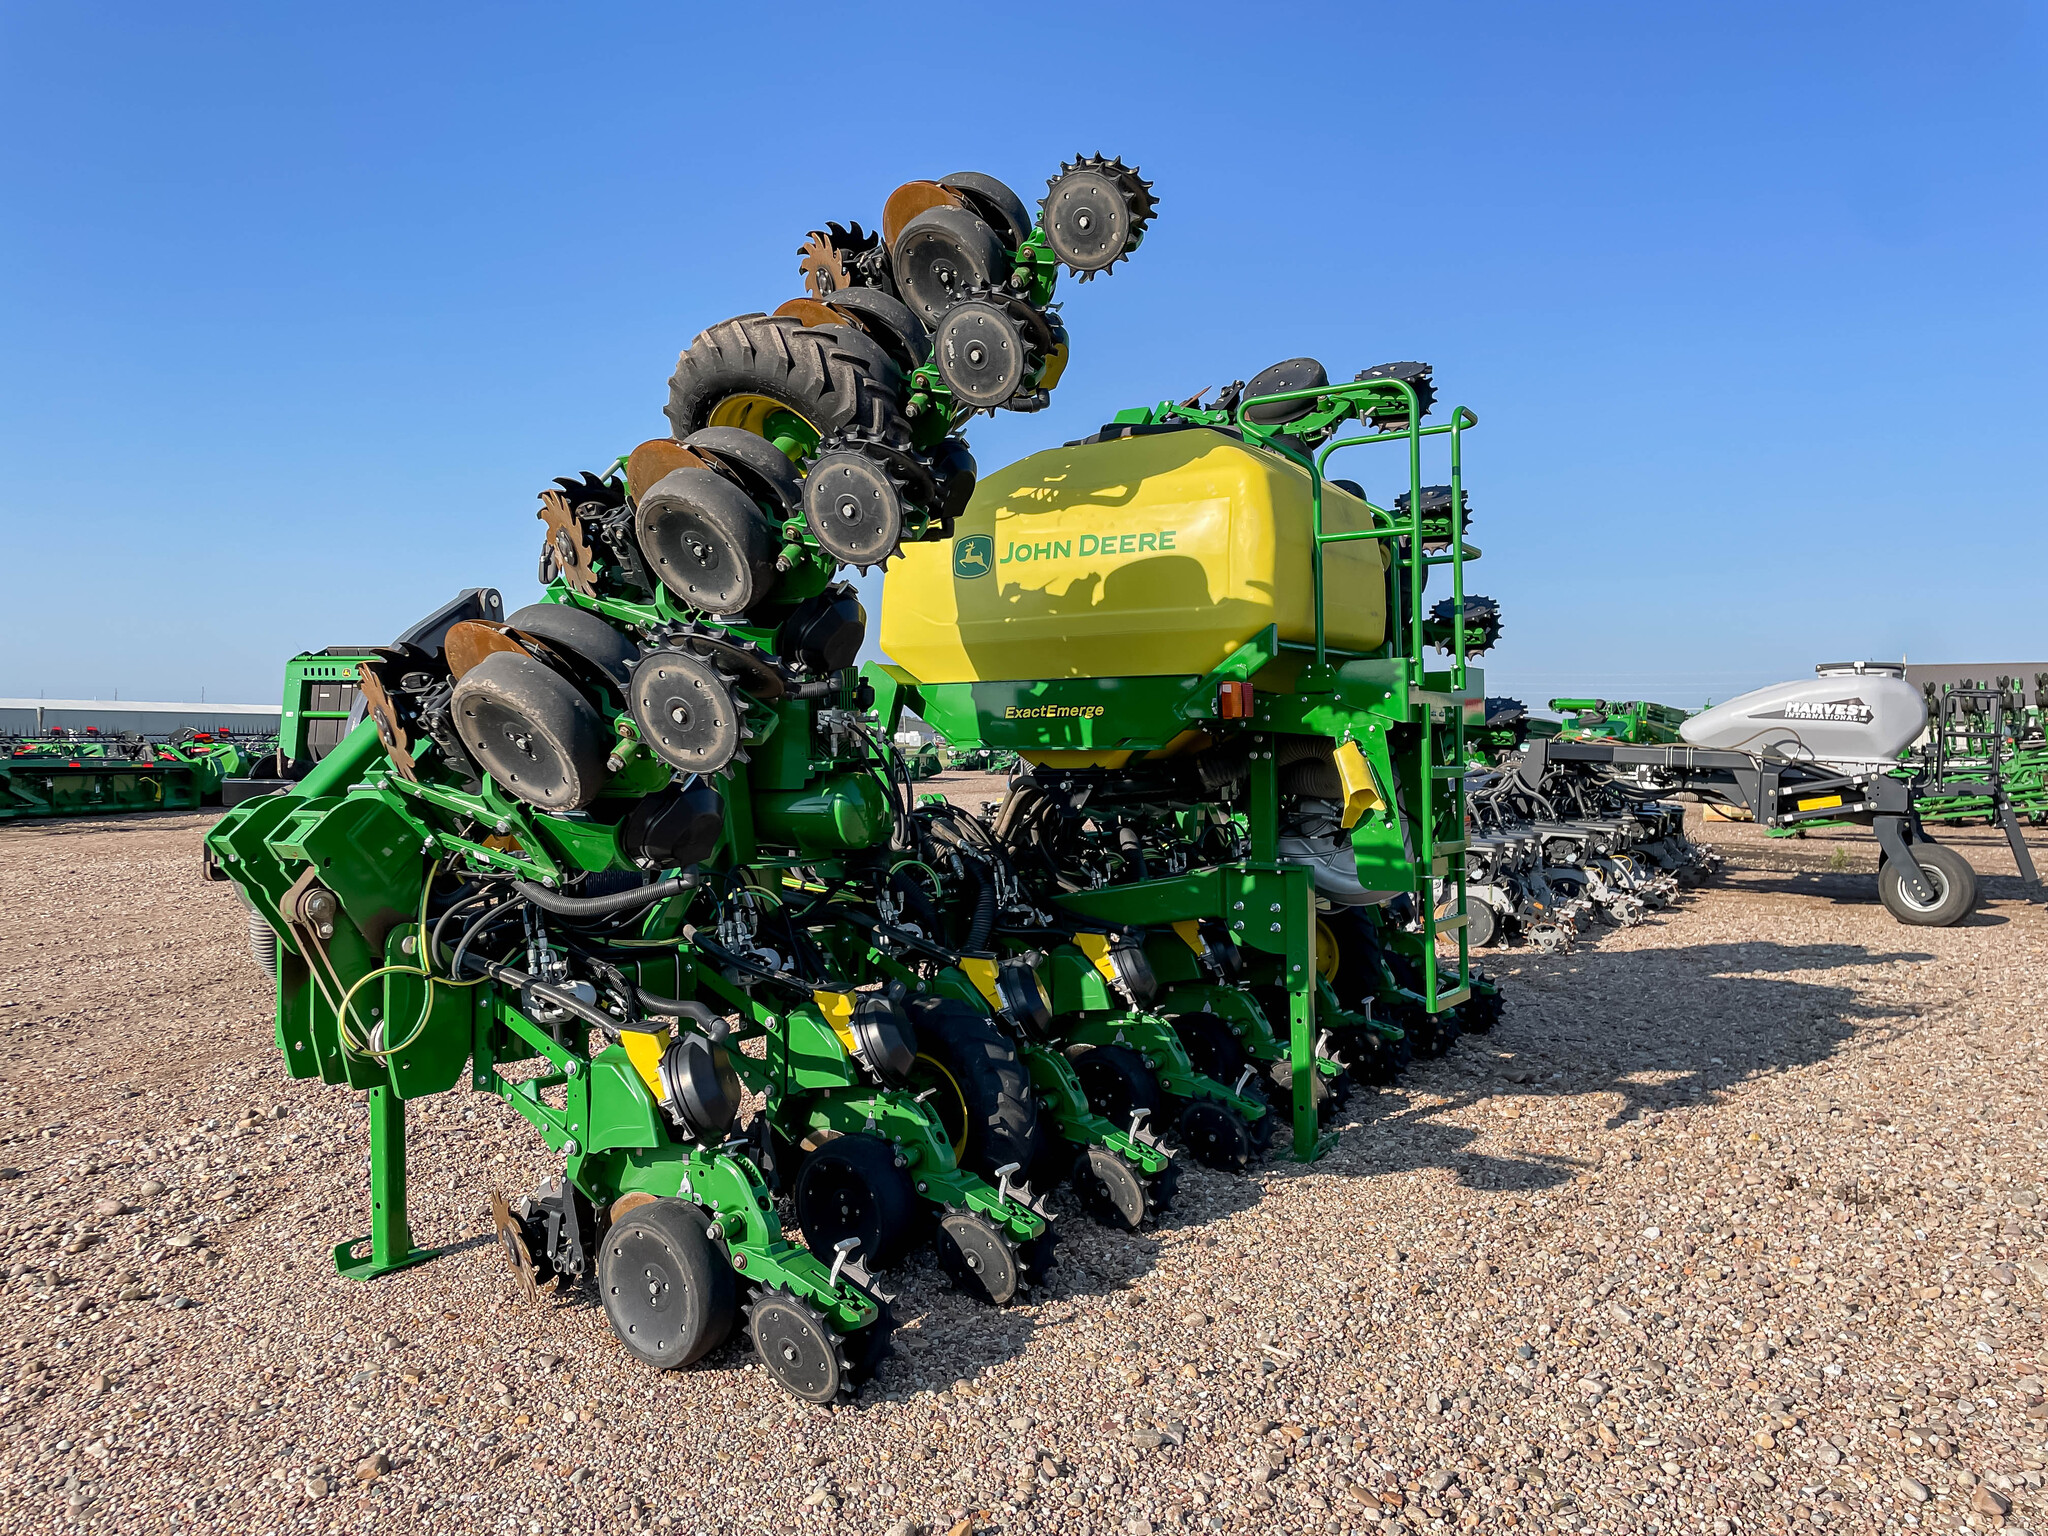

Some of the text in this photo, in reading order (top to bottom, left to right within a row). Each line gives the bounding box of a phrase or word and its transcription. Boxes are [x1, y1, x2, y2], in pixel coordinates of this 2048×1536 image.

[1000, 531, 1177, 564] JOHN DEERE
[1005, 705, 1104, 719] ExactEmerge
[1785, 702, 1871, 716] HARVEST
[1784, 712, 1858, 721] INTERNATIONAL
